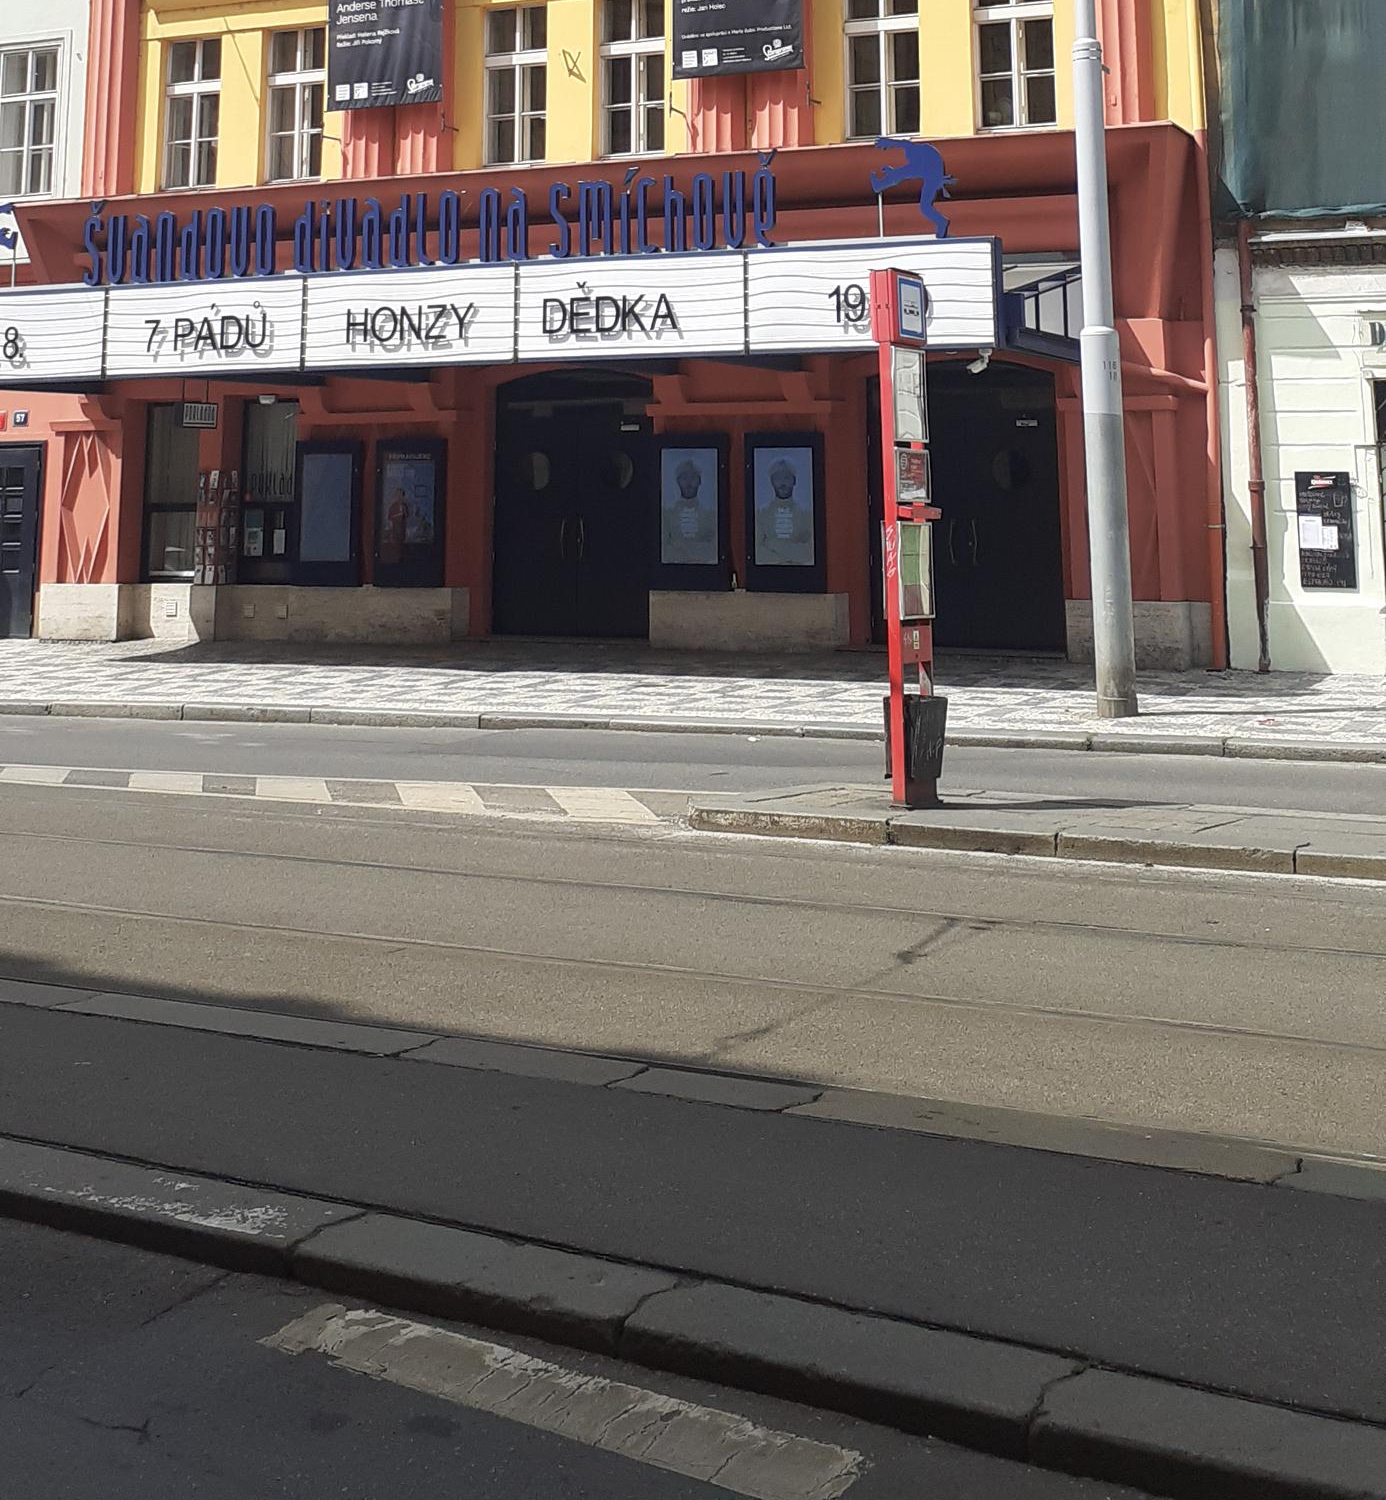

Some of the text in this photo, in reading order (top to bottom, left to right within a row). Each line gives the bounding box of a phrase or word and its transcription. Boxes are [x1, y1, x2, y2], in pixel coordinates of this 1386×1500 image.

[336, 1, 377, 14] Anderse
[336, 12, 378, 25] Jensena
[479, 186, 530, 263] na
[144, 320, 161, 353] 7
[173, 301, 267, 352] PÁDŮ
[346, 302, 474, 344] HONZY
[542, 281, 679, 335] DĚDKA
[16, 413, 25, 423] 57
